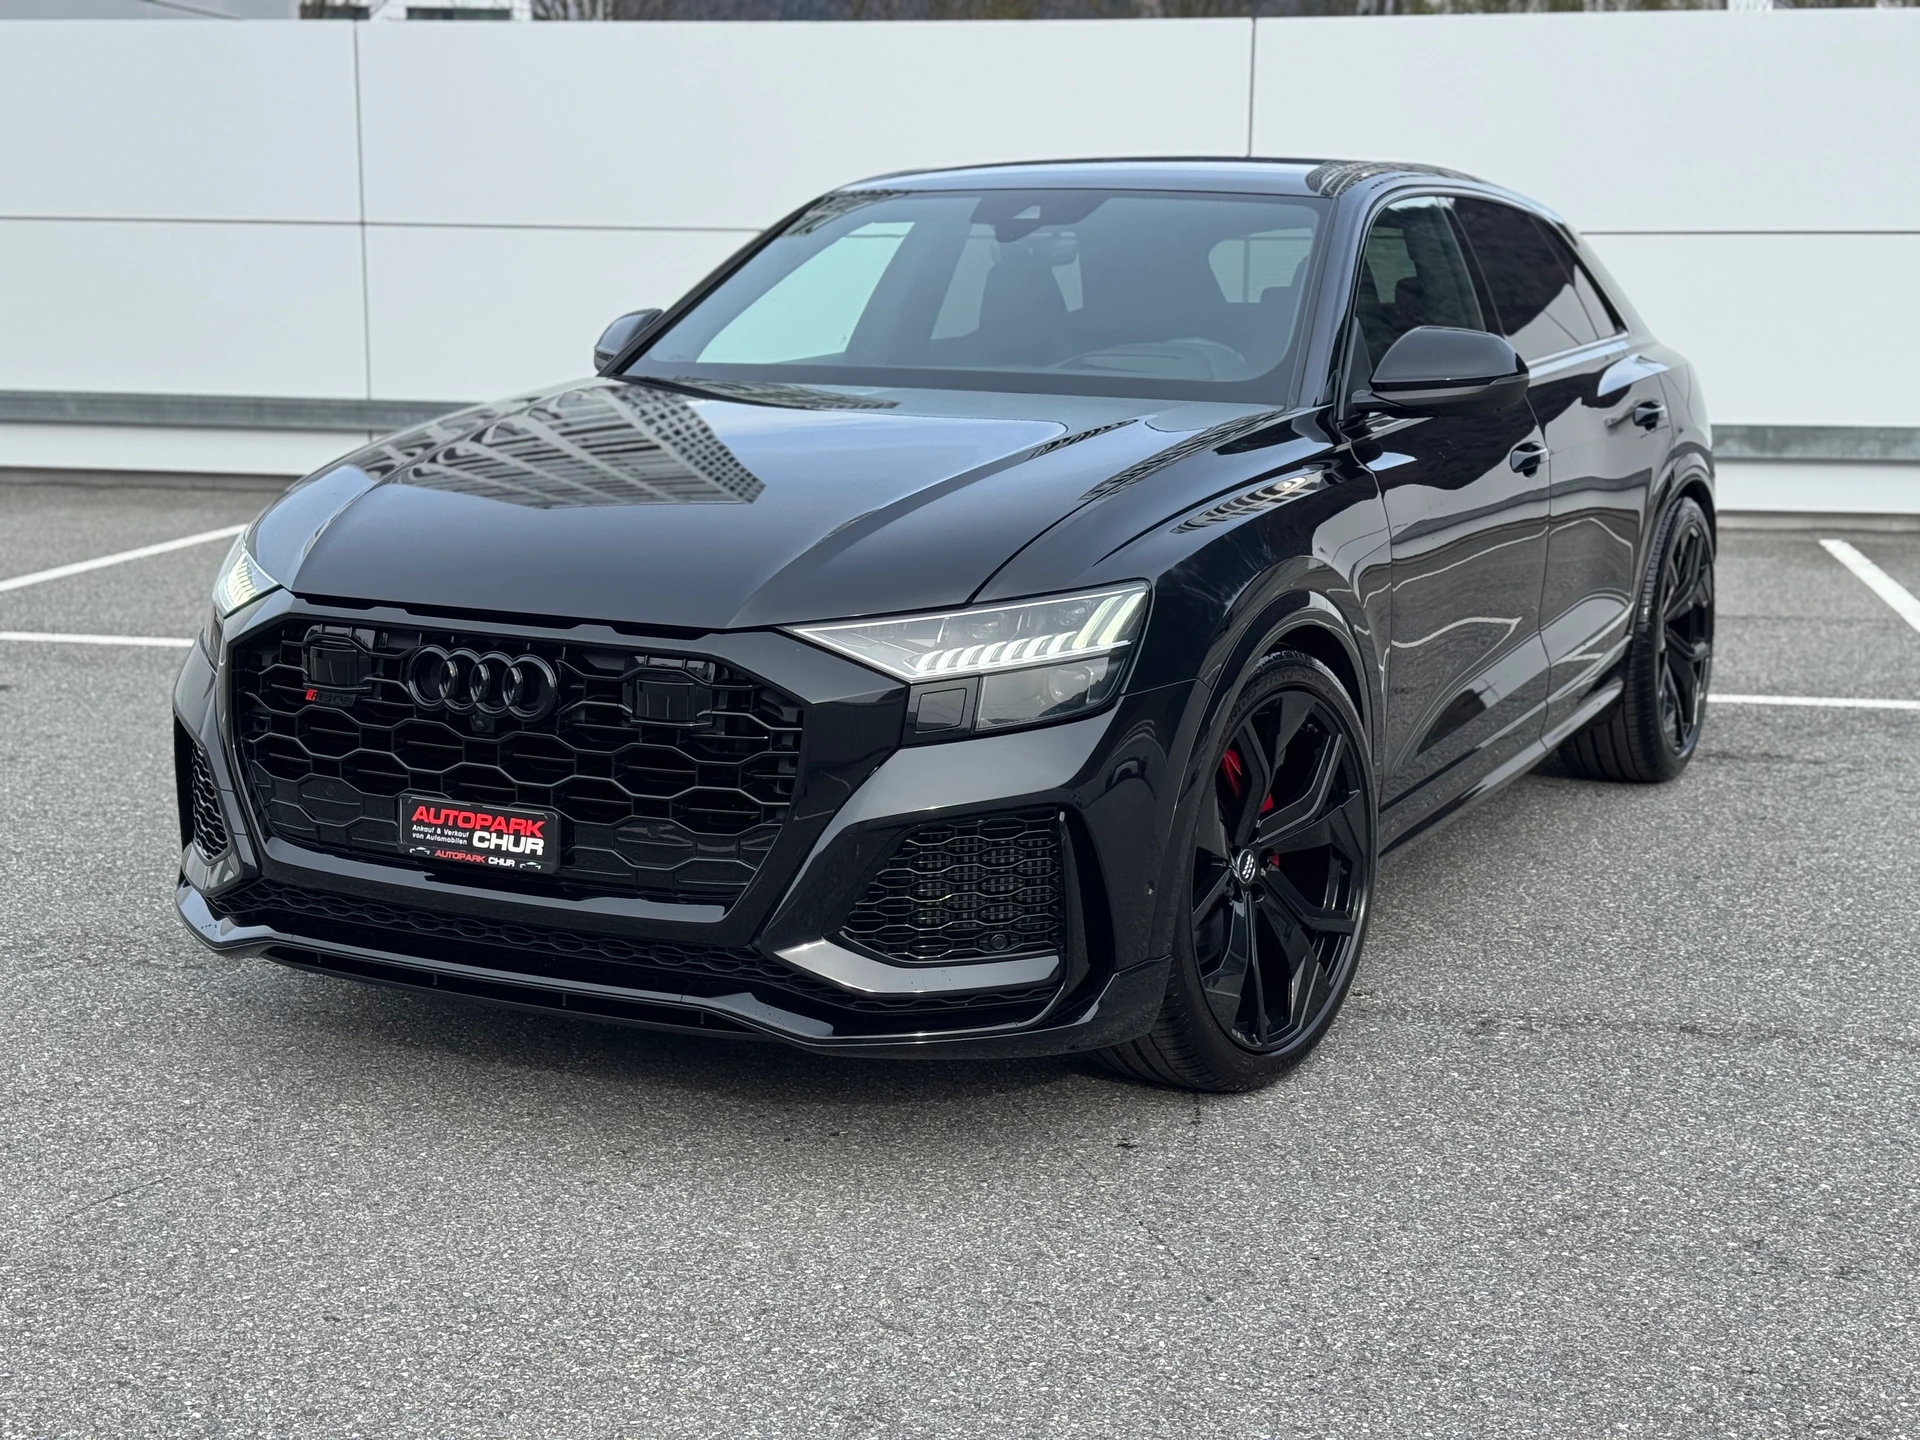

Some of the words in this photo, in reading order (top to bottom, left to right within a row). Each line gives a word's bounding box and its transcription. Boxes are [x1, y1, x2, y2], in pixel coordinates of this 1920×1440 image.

[412, 806, 545, 837] AUTOPARK
[412, 825, 435, 834] Ankauf
[436, 827, 442, 835] &
[444, 829, 469, 838] Verkauf
[412, 832, 425, 840] von
[425, 834, 468, 845] Automobilen
[472, 831, 545, 855] CHUR
[434, 850, 486, 863] AUTOPARK
[488, 856, 515, 867] CHUR
